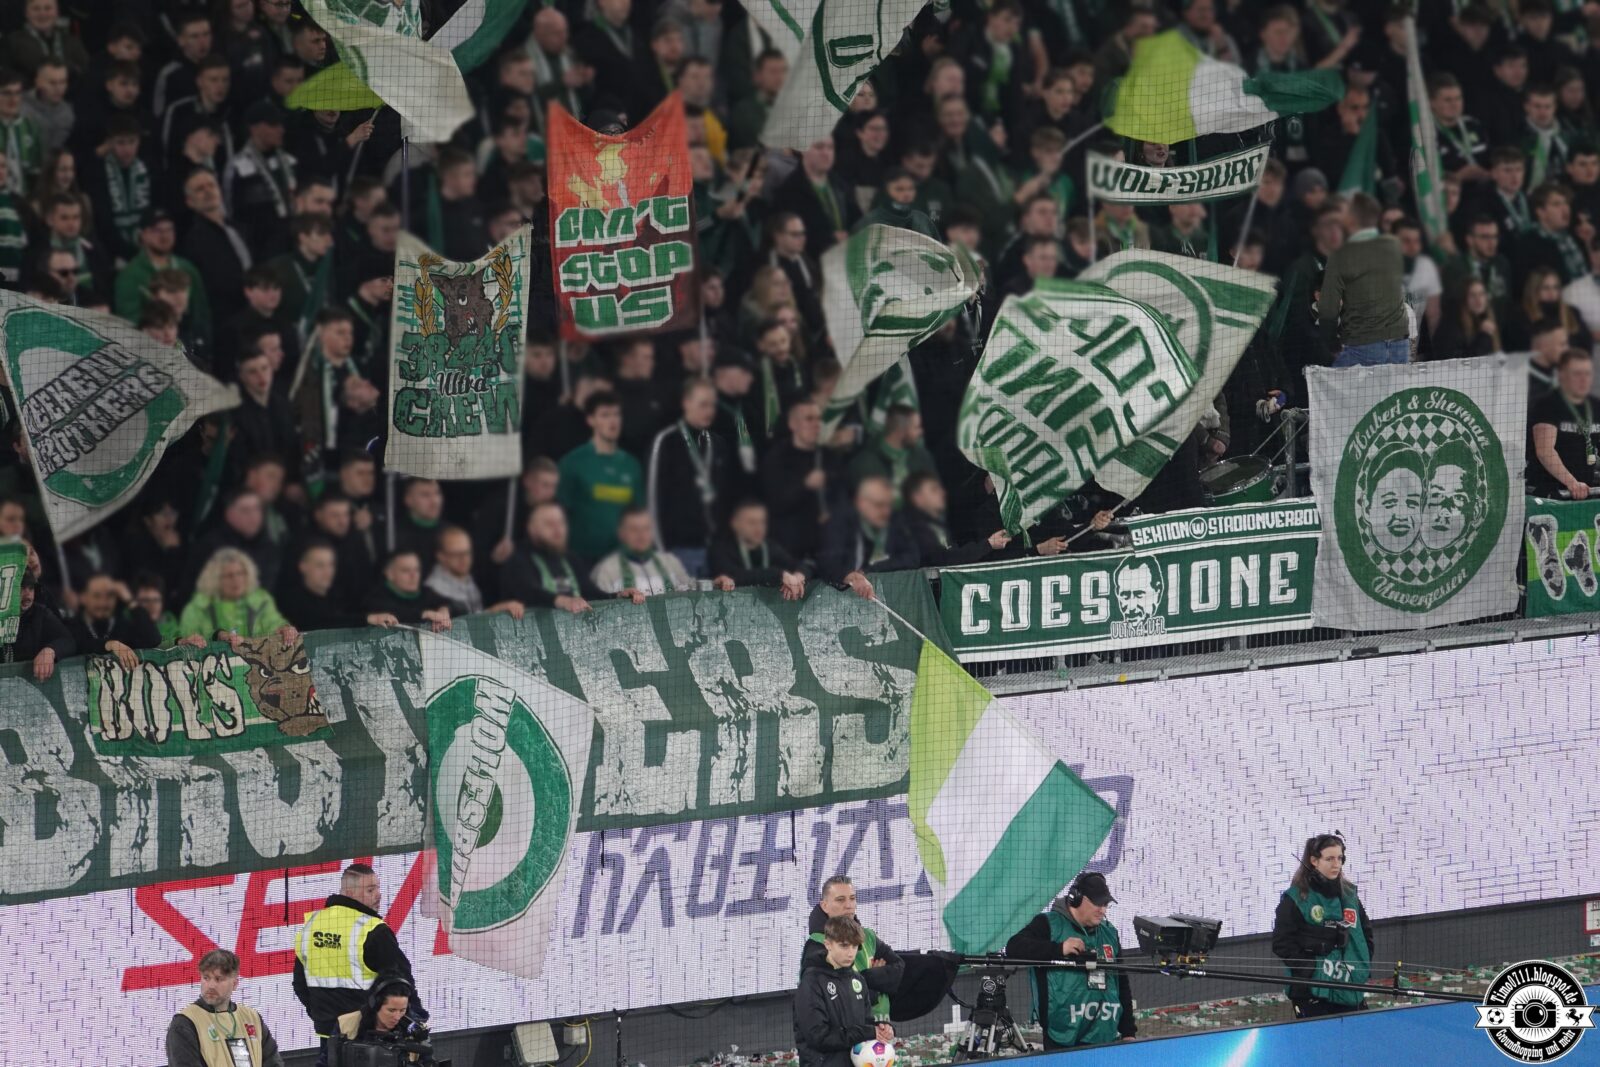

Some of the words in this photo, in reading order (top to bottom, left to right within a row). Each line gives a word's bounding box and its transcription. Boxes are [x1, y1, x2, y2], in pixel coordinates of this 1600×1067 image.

[1092, 152, 1263, 194] WOLFSBURG
[560, 240, 693, 293] STOP
[570, 286, 674, 335] US
[436, 371, 490, 396] Ultra
[1348, 399, 1402, 460] Hubert
[1407, 394, 1419, 410] &
[1424, 390, 1490, 449] Sherman
[1131, 521, 1191, 547] SEKTION
[1208, 508, 1321, 536] STADIONVERBOT
[1070, 1001, 1121, 1024] HOST
